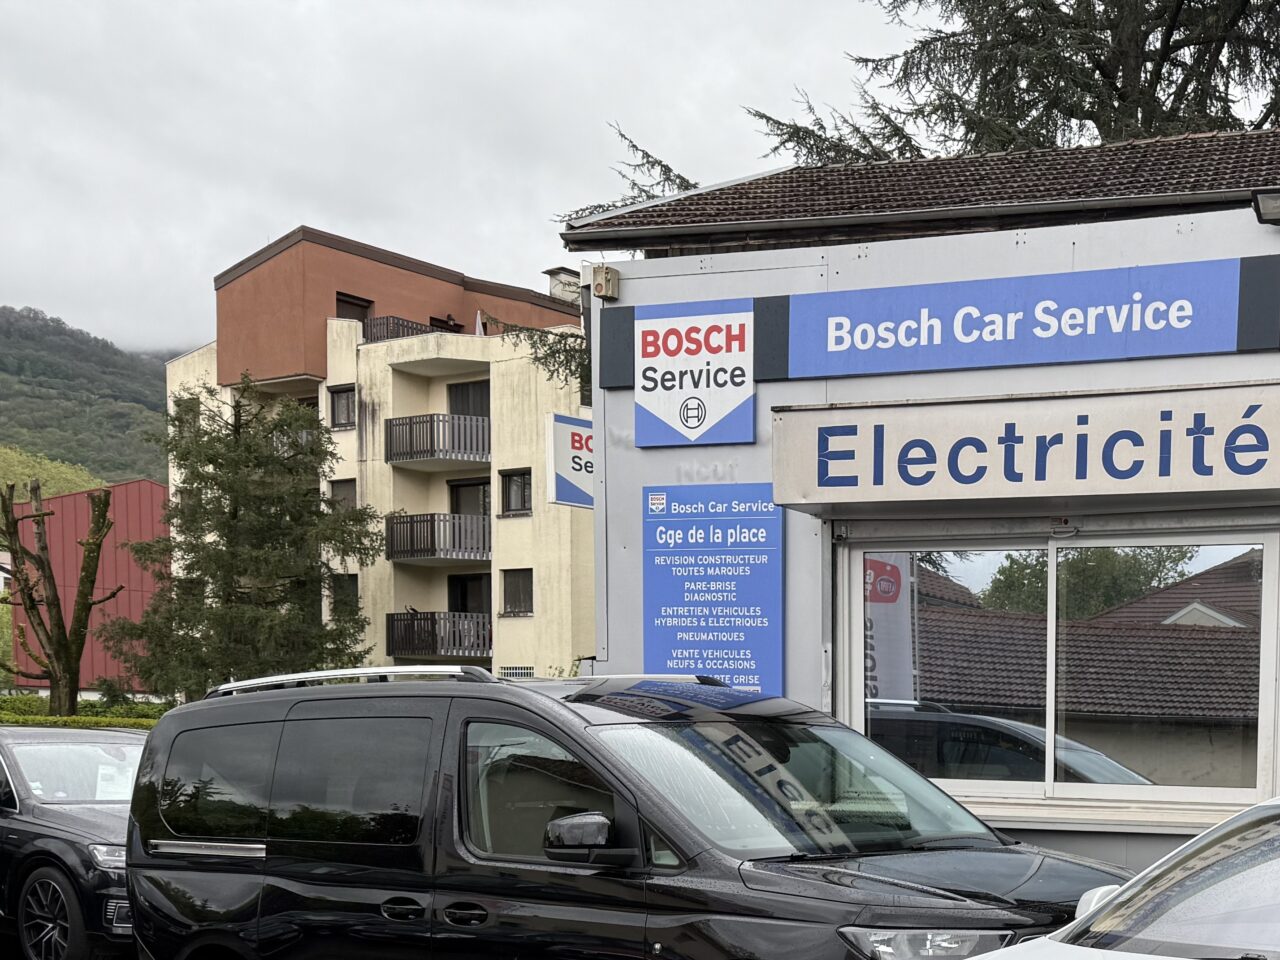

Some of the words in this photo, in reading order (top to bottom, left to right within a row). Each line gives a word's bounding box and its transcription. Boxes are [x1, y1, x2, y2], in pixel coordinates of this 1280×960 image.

[827, 307, 942, 352] Bosch
[952, 304, 1022, 344] Car
[1032, 291, 1193, 339] Service
[641, 323, 746, 359] BOSCH
[641, 361, 746, 393] Service
[817, 404, 1270, 488] Electricité
[671, 502, 705, 514] Bosch
[708, 501, 728, 513] Car
[731, 500, 775, 512] Service
[655, 526, 684, 548] Gge
[687, 525, 705, 543] de
[709, 525, 723, 543] la
[727, 525, 767, 547] place
[654, 556, 695, 565] REVISION
[697, 555, 769, 565] CONSTRUCTEUR
[671, 567, 705, 576] TOUTES
[707, 566, 751, 576] MARQUES
[684, 582, 737, 591] PARE-BRISE
[684, 593, 737, 602] DIAGNOSTIC
[661, 606, 709, 616] ENTRETIEN
[711, 606, 762, 616] VEHICULES
[654, 617, 698, 627] HYBRIDES
[700, 618, 706, 627] &
[708, 617, 769, 627] ELECTRIQUES
[676, 632, 745, 641] PNEUMATIQUES
[671, 649, 700, 658] VENTE
[702, 649, 752, 659] VEHICULES
[666, 660, 696, 669] NEUFS
[697, 660, 703, 668] &
[705, 660, 756, 669] OCCASIONS
[733, 674, 760, 684] GRISE
